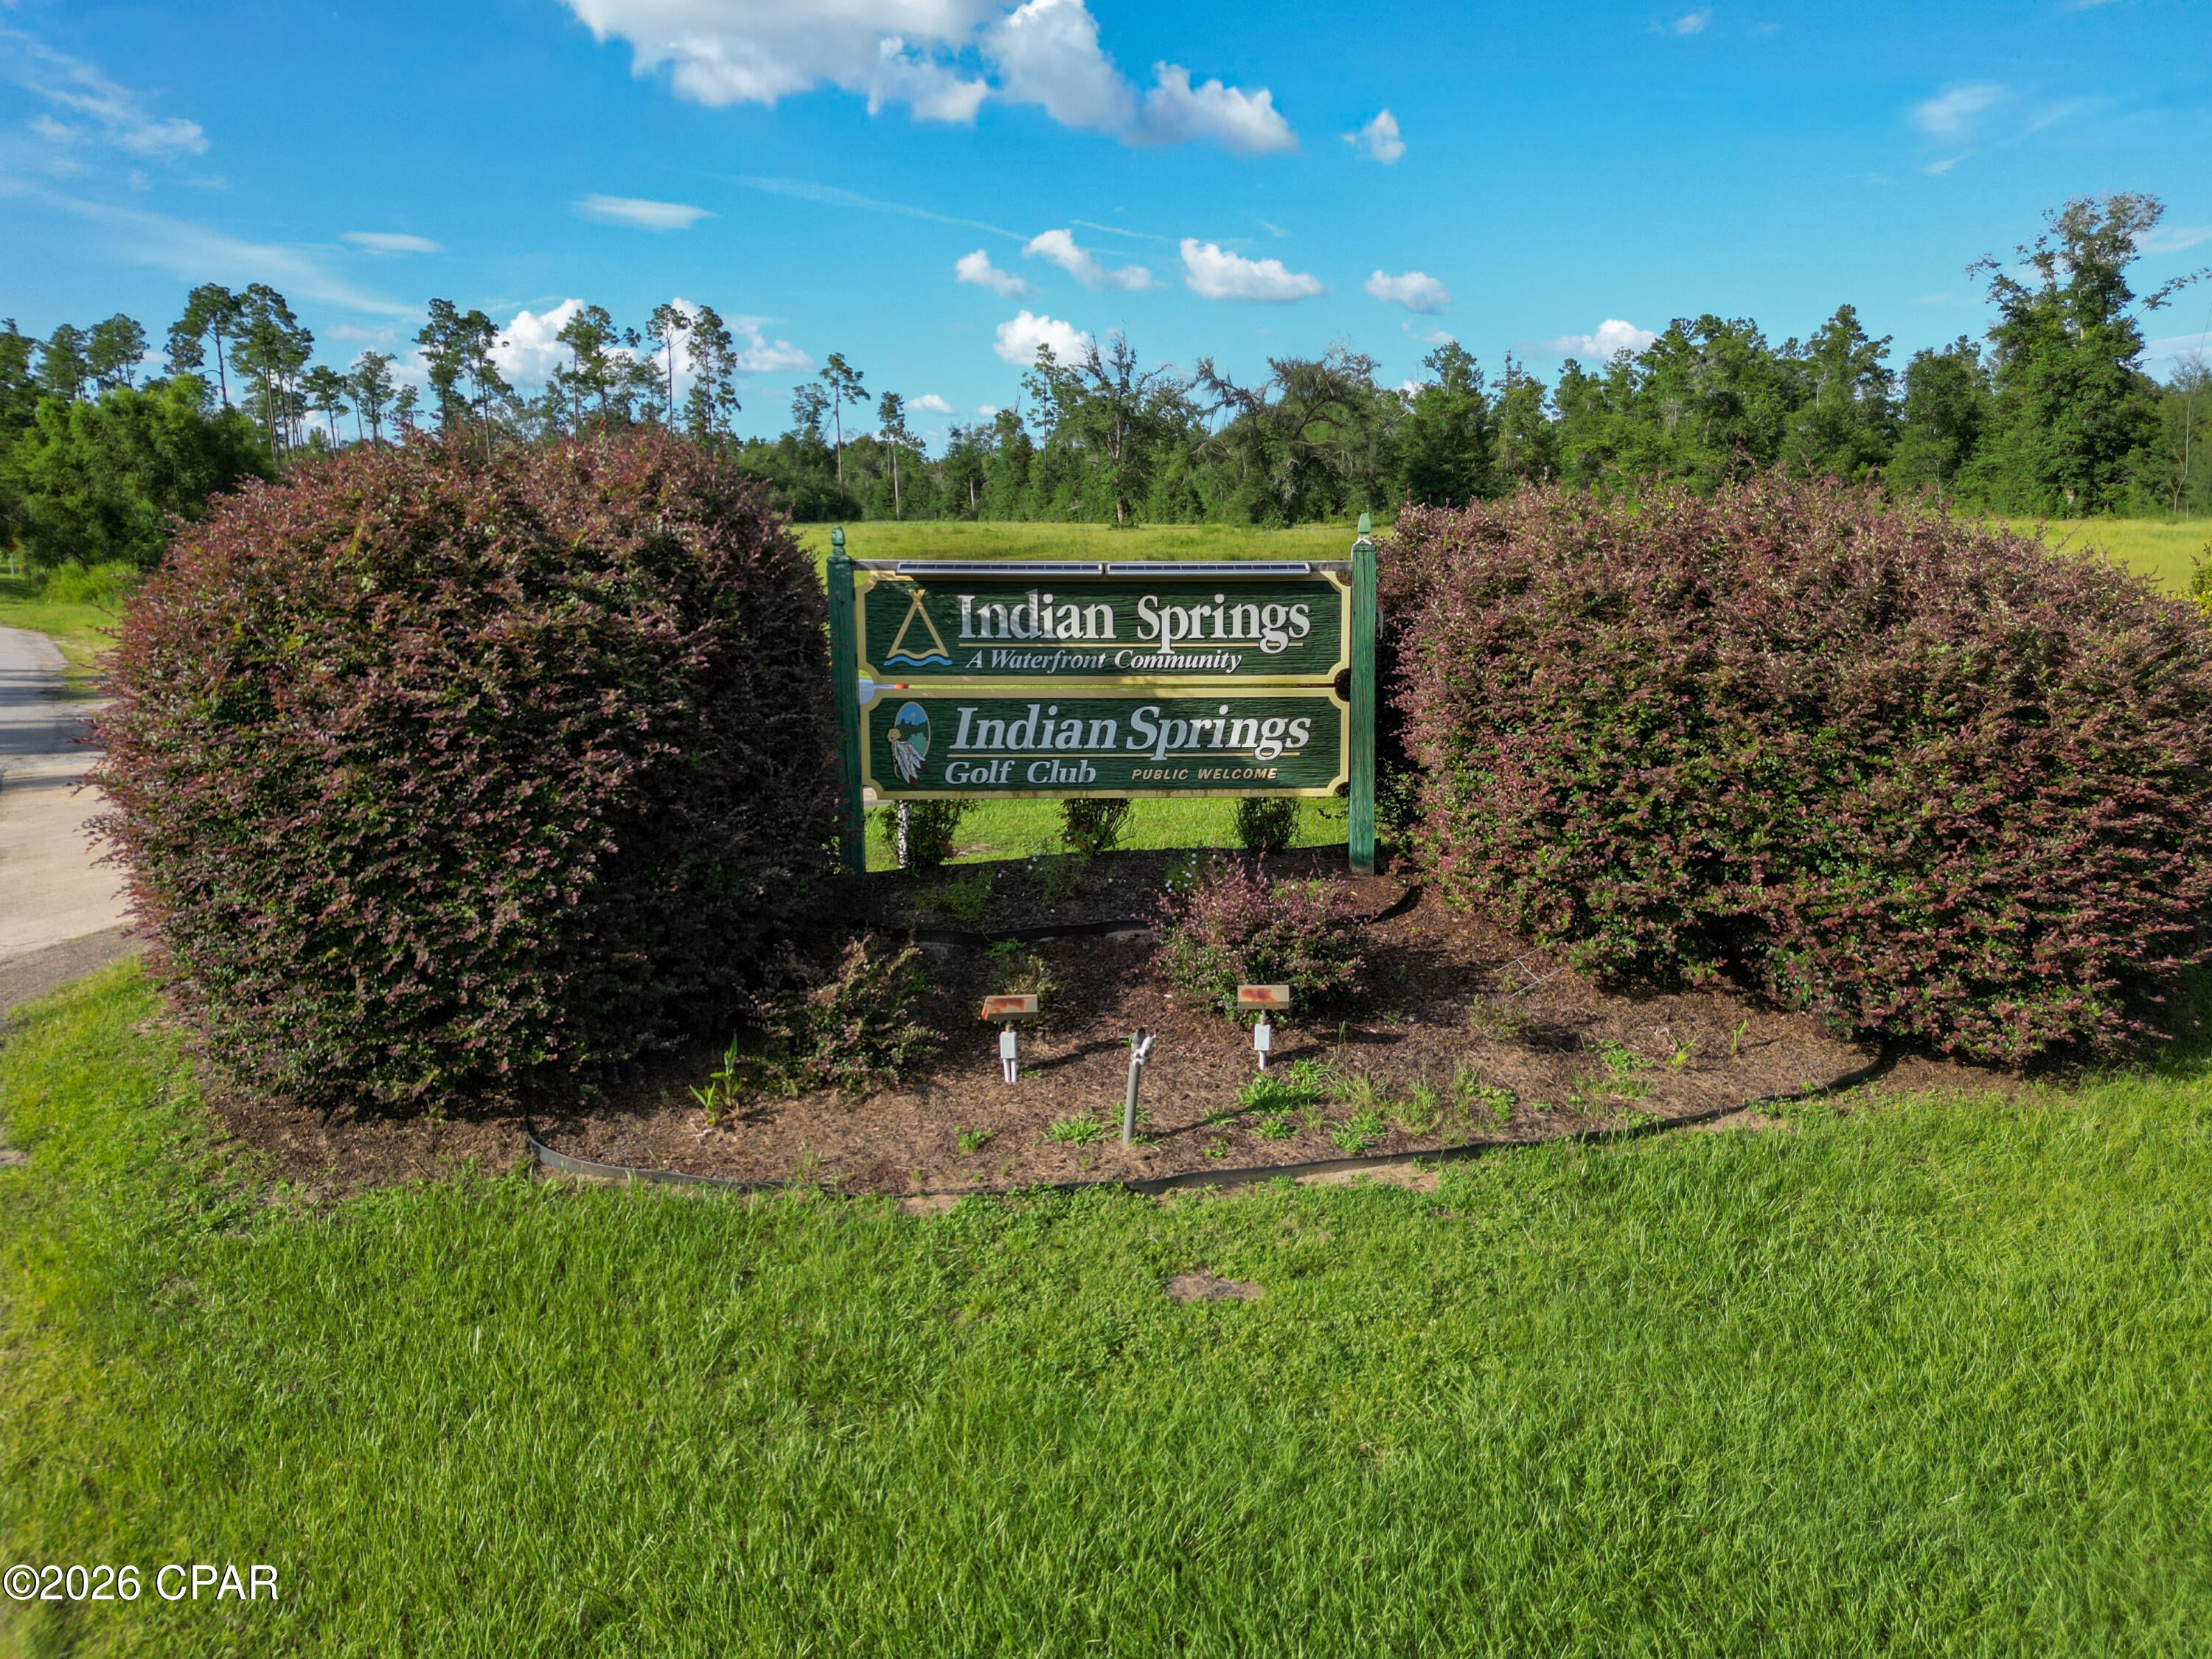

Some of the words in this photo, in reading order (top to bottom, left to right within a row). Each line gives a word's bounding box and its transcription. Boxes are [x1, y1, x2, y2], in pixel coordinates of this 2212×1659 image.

[959, 589, 1116, 639] Indian
[1137, 594, 1310, 654] Springs
[966, 650, 984, 669] A
[992, 650, 1106, 673] Waterfront
[1115, 649, 1242, 673] Community
[949, 704, 1116, 751] Indian
[1126, 705, 1311, 760] Springs
[945, 760, 1015, 785] Golf
[1026, 760, 1096, 785] Club
[1131, 768, 1189, 781] PUBLIC
[1197, 768, 1277, 780] WELCOME
